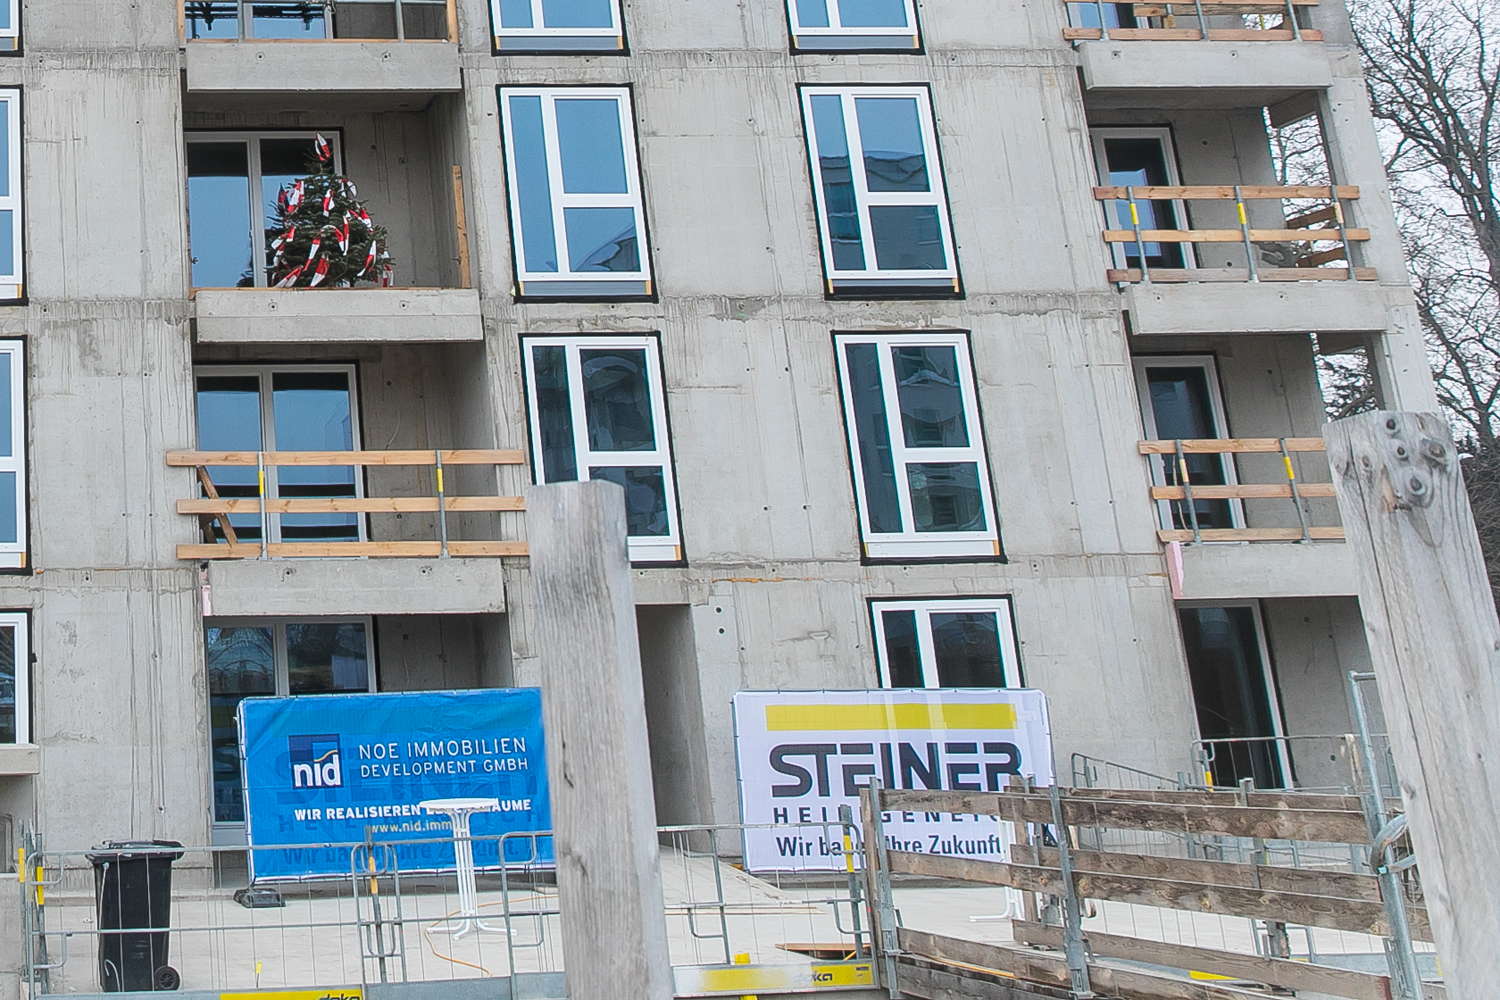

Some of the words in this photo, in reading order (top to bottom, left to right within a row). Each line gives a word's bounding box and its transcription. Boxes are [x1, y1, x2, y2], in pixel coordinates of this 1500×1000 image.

[359, 743, 399, 760] NOE
[407, 737, 527, 758] IMMOBILIEN
[294, 753, 341, 787] nid
[361, 760, 476, 778] DEVELOPMENT
[483, 757, 529, 773] GMBH
[769, 742, 1022, 798] STEINER
[294, 808, 322, 821] WIR
[326, 803, 421, 820] REALISIEREN
[776, 836, 812, 856] Wir
